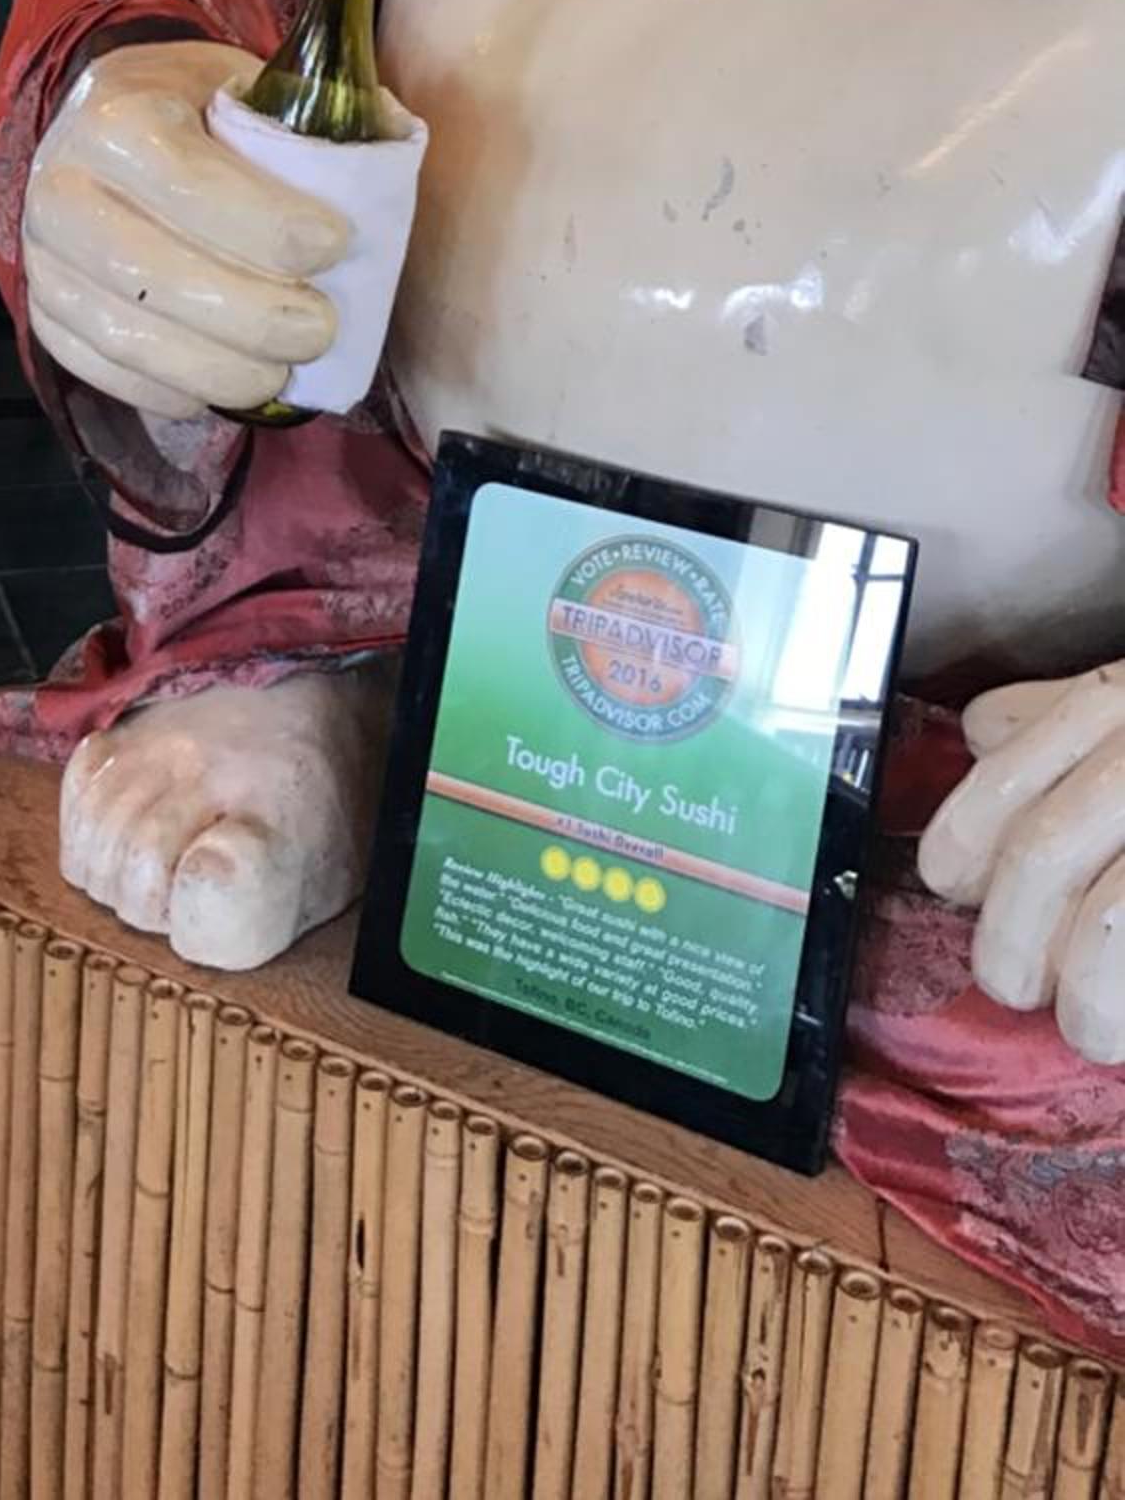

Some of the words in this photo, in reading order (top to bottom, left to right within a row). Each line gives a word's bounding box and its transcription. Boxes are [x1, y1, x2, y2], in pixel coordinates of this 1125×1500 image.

[571, 549, 614, 585] VOTE
[622, 543, 691, 576] REVIEW
[562, 605, 723, 667] TRIPADVISOR
[608, 659, 662, 693] 2016
[505, 735, 586, 791] Tough
[595, 761, 652, 815] City
[660, 779, 738, 836] Sushi
[571, 919, 600, 937] food
[603, 930, 628, 947] and
[630, 940, 665, 962] great
[639, 925, 666, 941] with
[669, 936, 678, 946] a
[682, 940, 710, 956] nice
[715, 952, 744, 968] view
[748, 961, 764, 976] of
[492, 947, 512, 960] the
[571, 974, 586, 987] of
[587, 982, 609, 997] our
[612, 989, 633, 1006] trip
[637, 999, 650, 1011] to
[545, 947, 554, 959] a
[644, 982, 657, 994] at
[662, 989, 697, 1010] good
